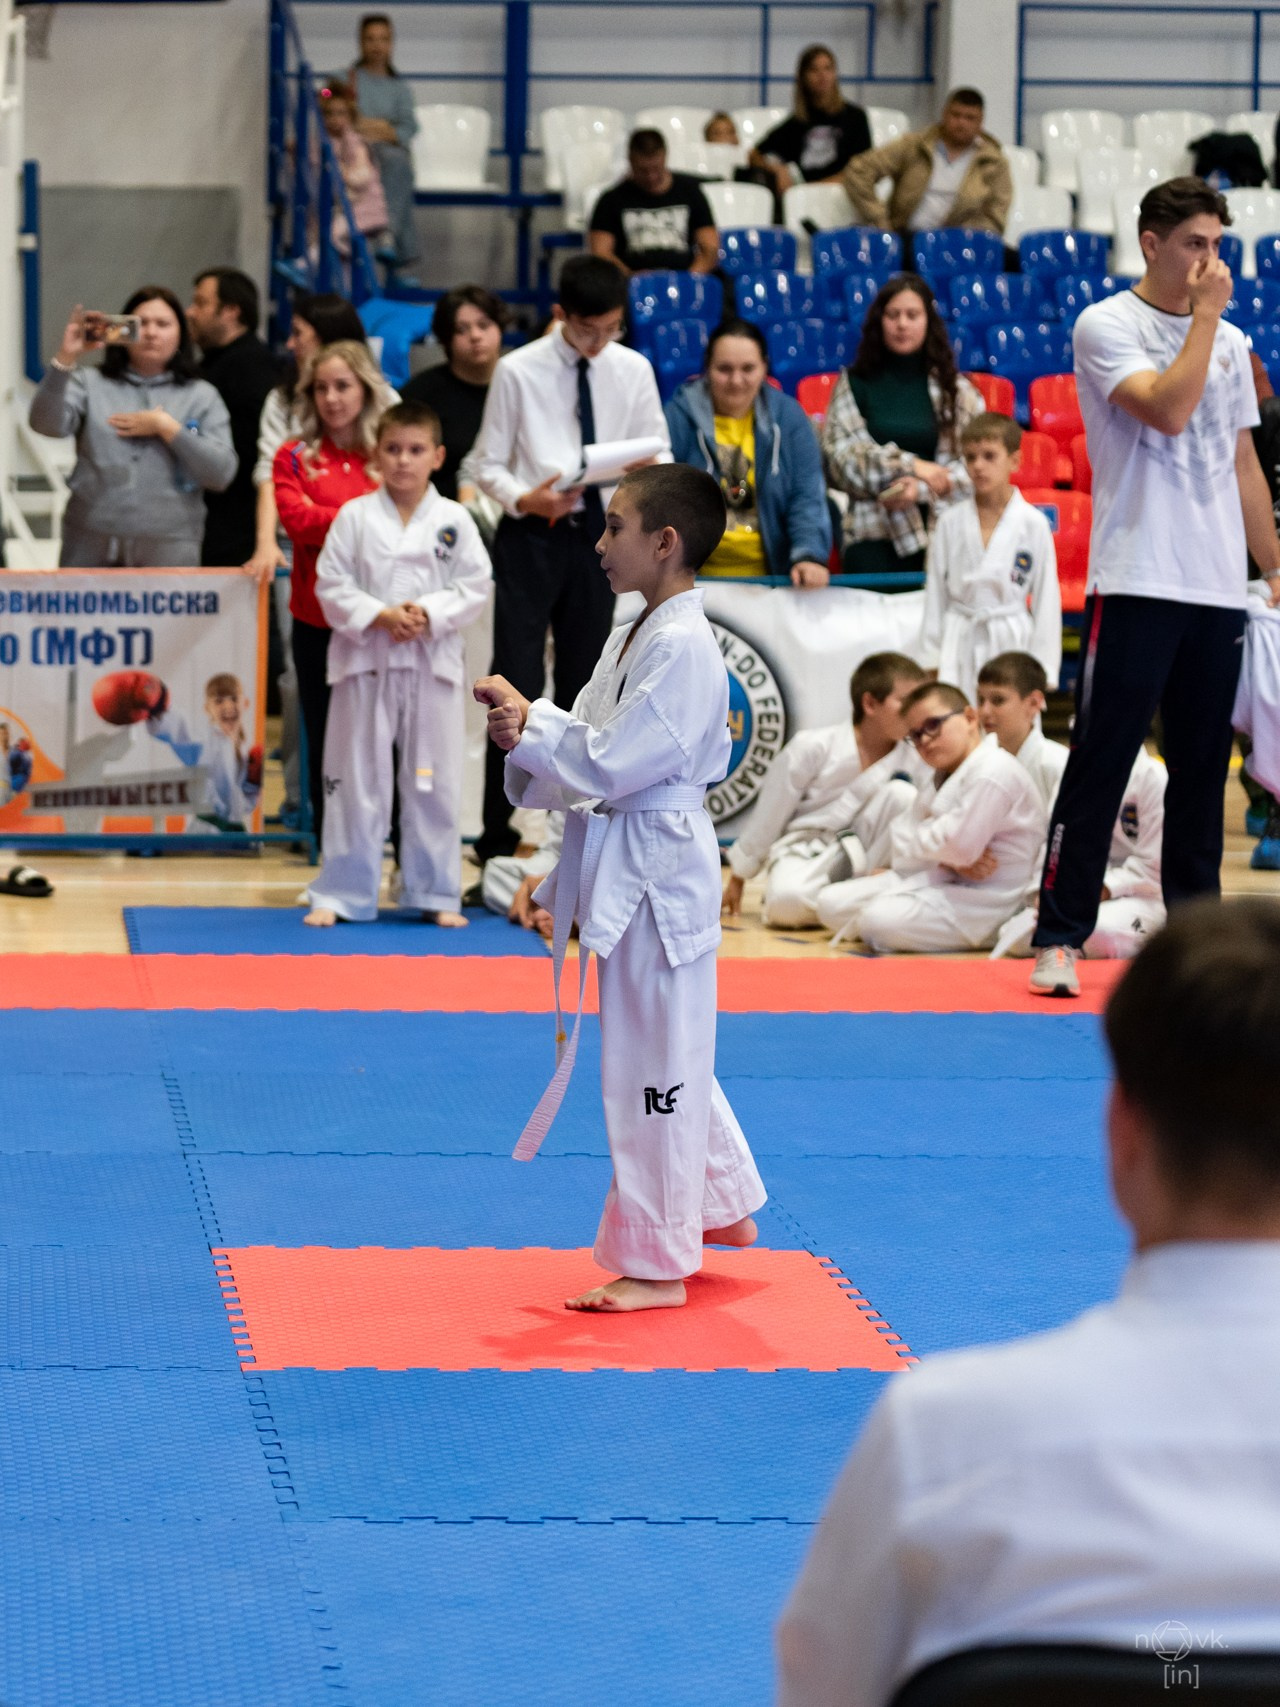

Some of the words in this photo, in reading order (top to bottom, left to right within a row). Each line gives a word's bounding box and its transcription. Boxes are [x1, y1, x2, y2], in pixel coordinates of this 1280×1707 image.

[31, 627, 154, 666] (МФТ)
[714, 628, 767, 689] N-DO
[708, 697, 780, 817] FEDERATIO
